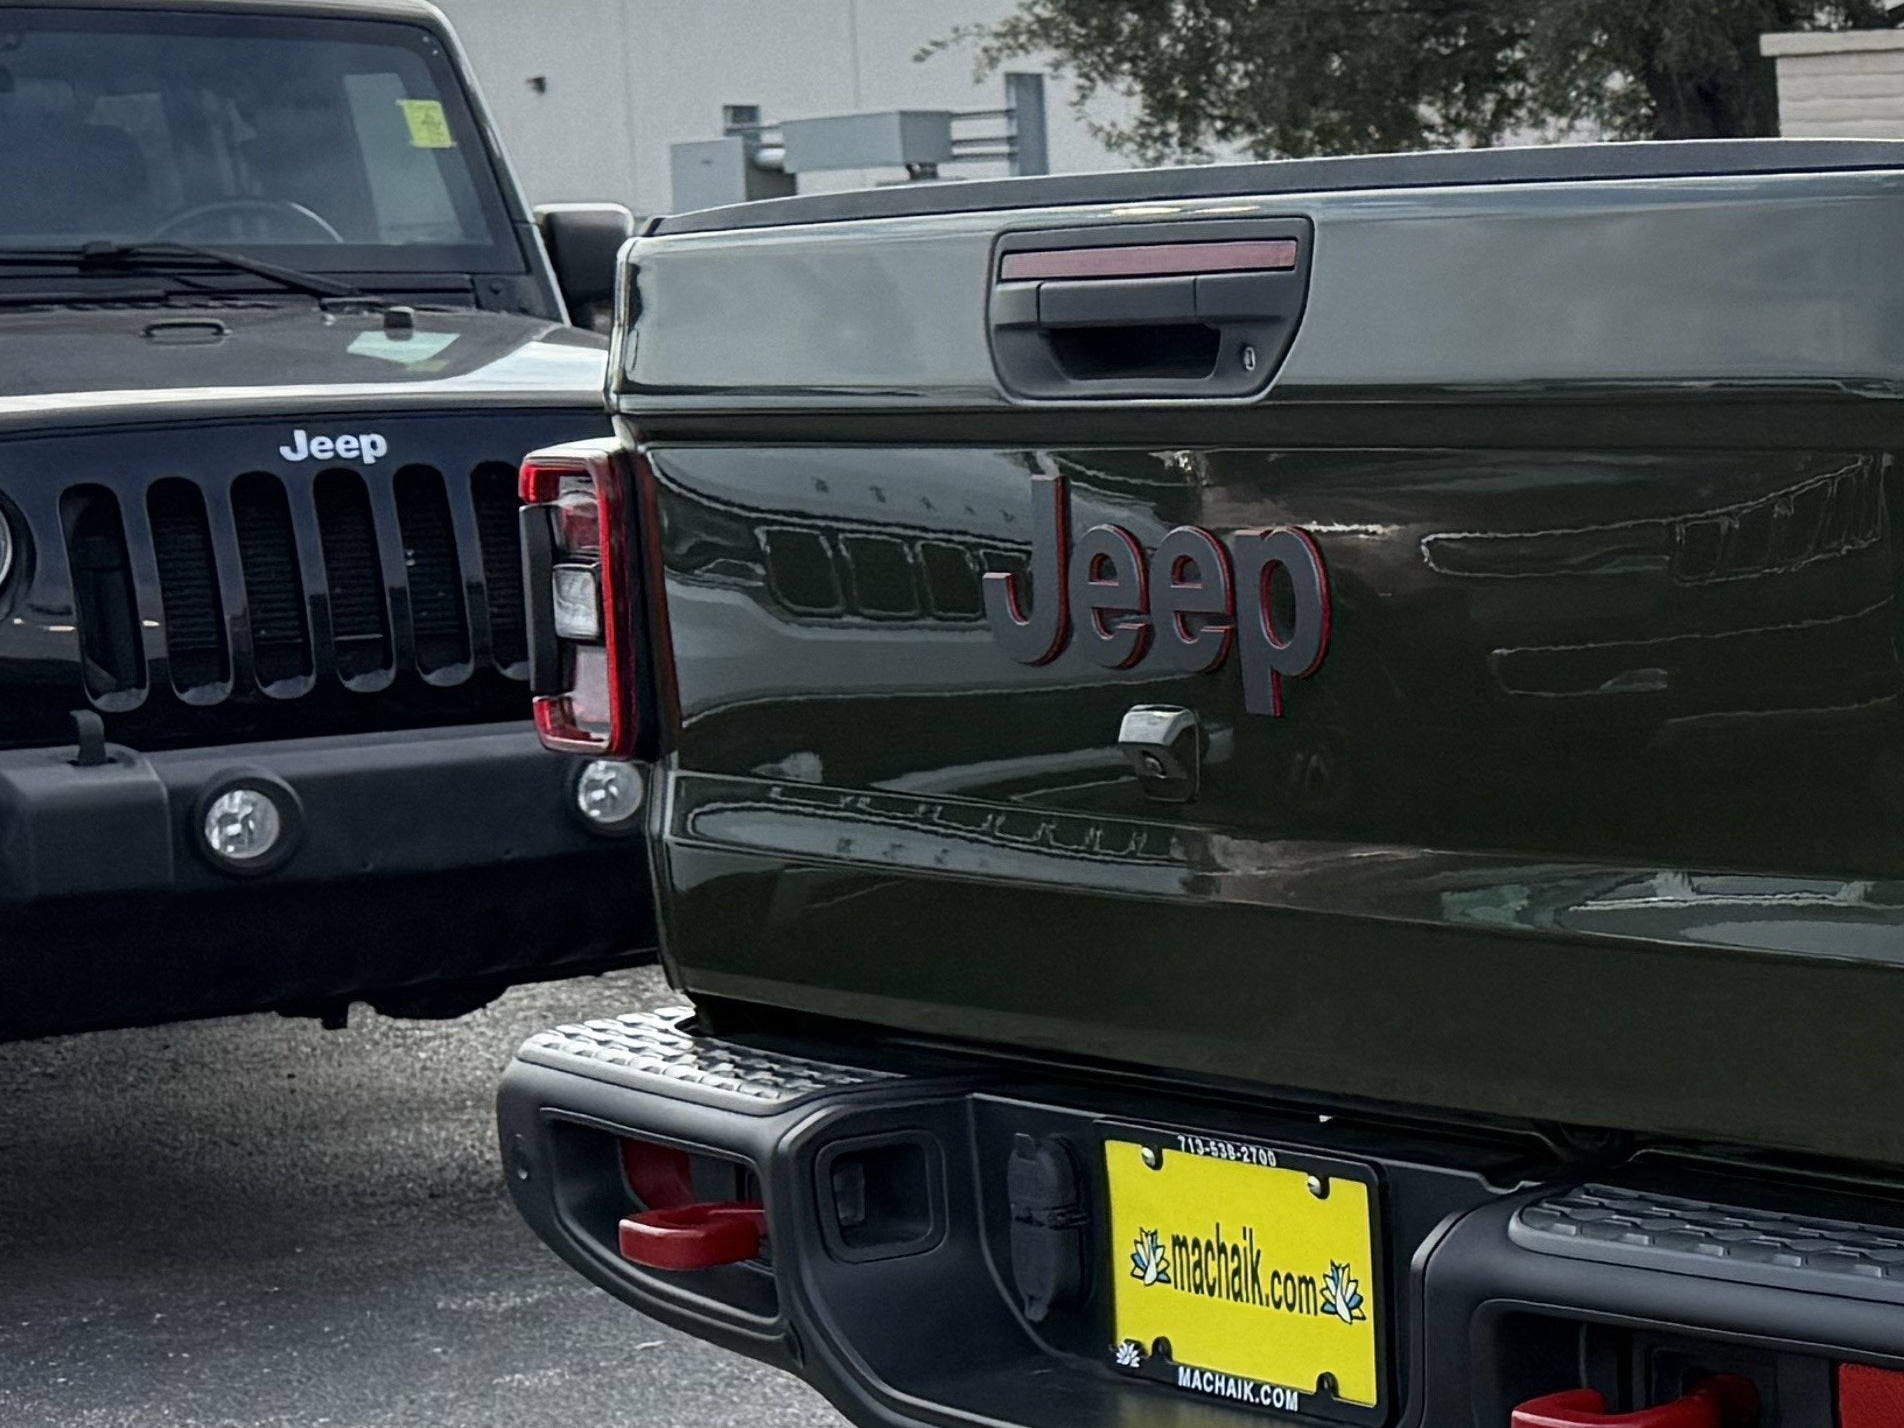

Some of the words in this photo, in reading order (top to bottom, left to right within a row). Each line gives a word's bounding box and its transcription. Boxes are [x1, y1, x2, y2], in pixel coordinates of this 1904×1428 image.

[279, 429, 388, 465] Jeep
[982, 474, 1332, 718] Jeep
[1170, 1222, 1319, 1316] machaik.com
[1178, 1367, 1299, 1411] MACHAIK.COM
